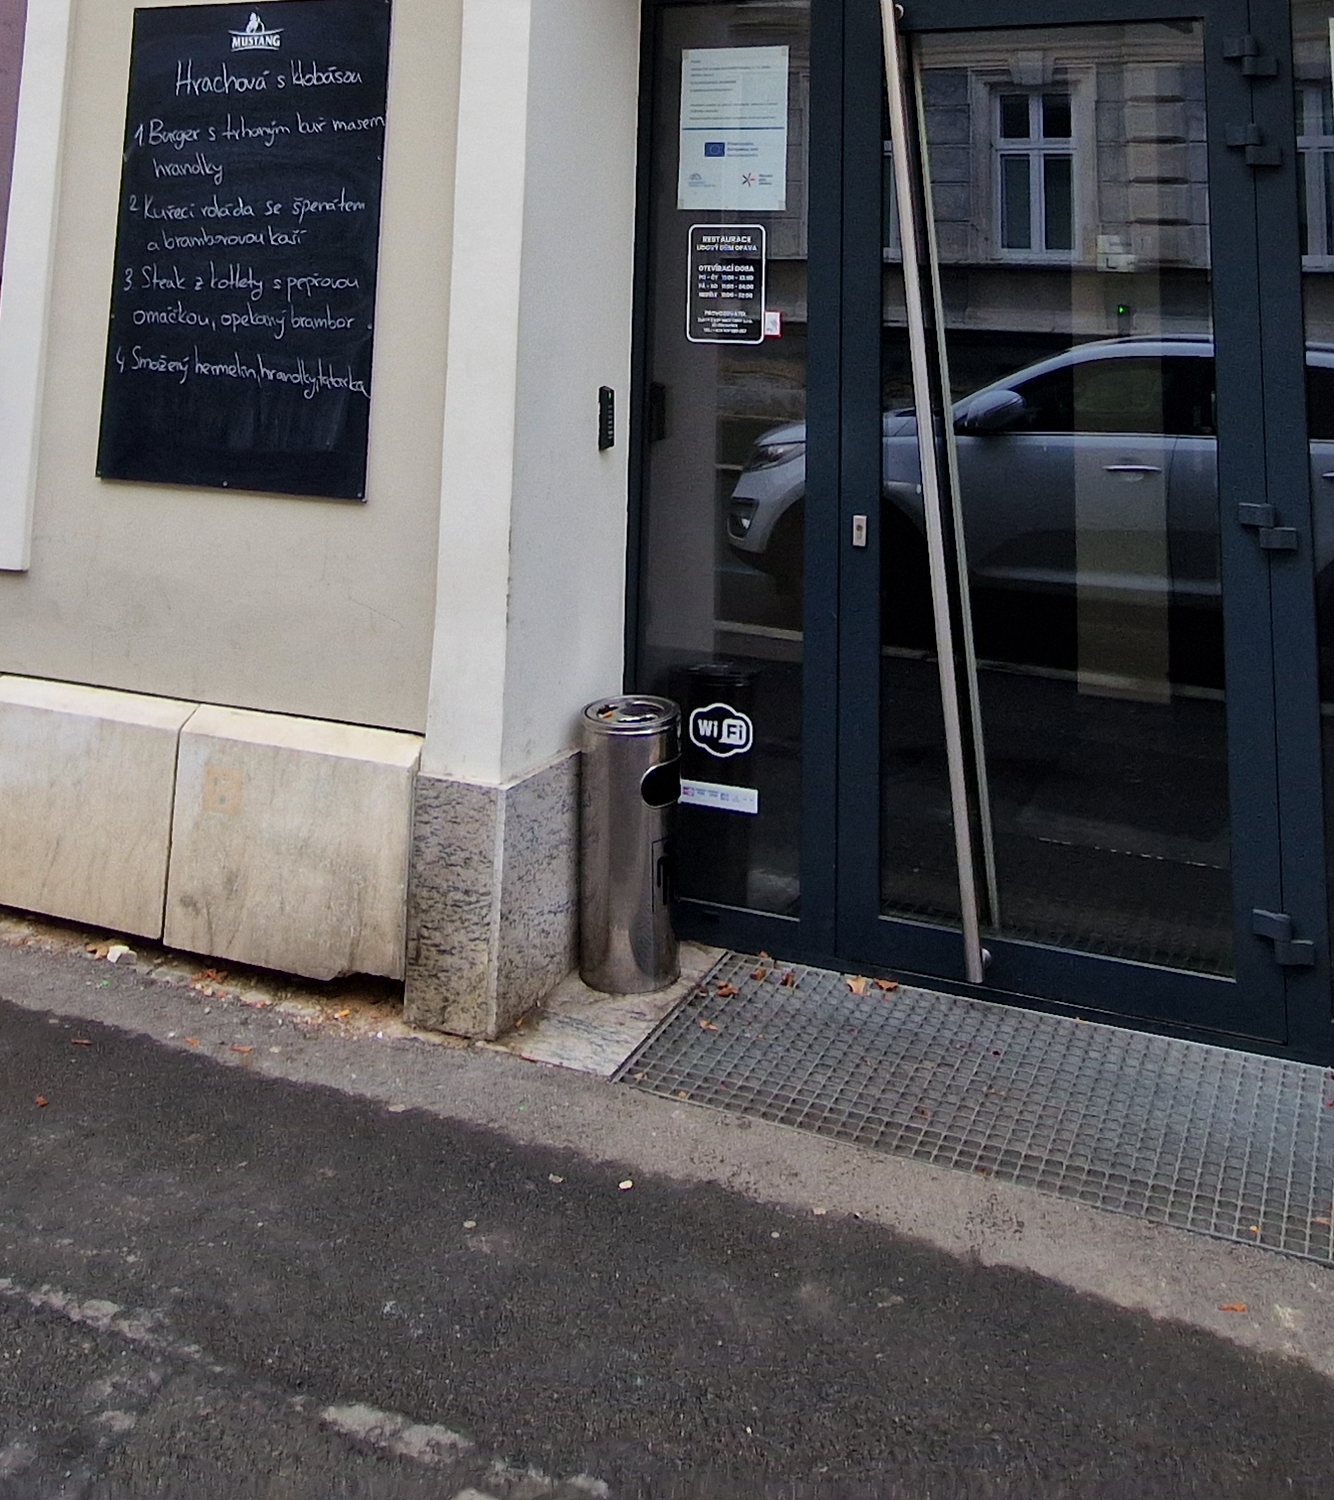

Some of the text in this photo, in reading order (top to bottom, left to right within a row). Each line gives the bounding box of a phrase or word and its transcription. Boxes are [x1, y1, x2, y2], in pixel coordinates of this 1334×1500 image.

[231, 35, 281, 48] MUSTANG
[175, 60, 269, 96] Hrachová
[277, 76, 286, 89] s
[149, 118, 200, 150] Burger
[208, 126, 216, 141] s
[332, 116, 386, 132] masem
[152, 152, 223, 186] hranolky
[265, 200, 282, 216] se
[292, 187, 366, 223] špenátem
[147, 239, 160, 251] a
[161, 227, 264, 248] bramborovou
[702, 235, 752, 243] RESTAURACE
[141, 262, 186, 290] Steak
[194, 276, 204, 290] z
[210, 261, 264, 300] kotlety
[273, 278, 282, 290] s
[287, 272, 360, 301] pepřovou
[290, 303, 355, 330] brambor
[131, 345, 189, 384] Smažený
